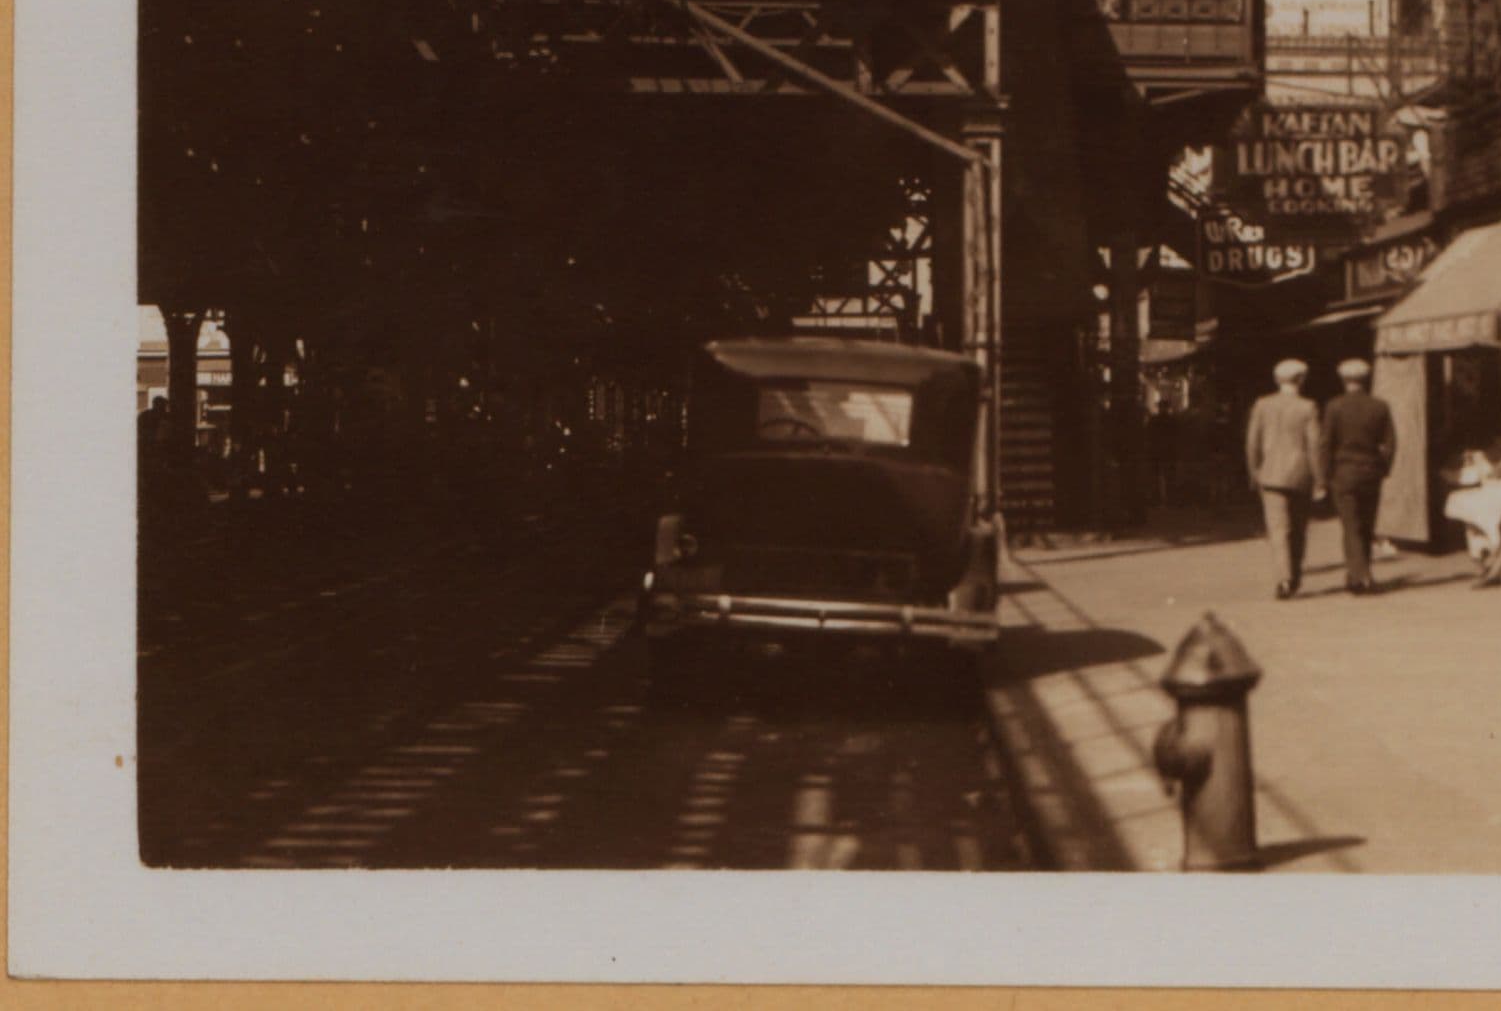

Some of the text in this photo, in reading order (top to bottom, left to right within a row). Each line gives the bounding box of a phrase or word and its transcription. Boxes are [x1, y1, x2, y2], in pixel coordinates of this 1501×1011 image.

[1237, 140, 1334, 175] LUNCH
[1264, 176, 1374, 199] HOME
[1267, 198, 1374, 214] COOKING
[1207, 244, 1302, 273] DRUGS
